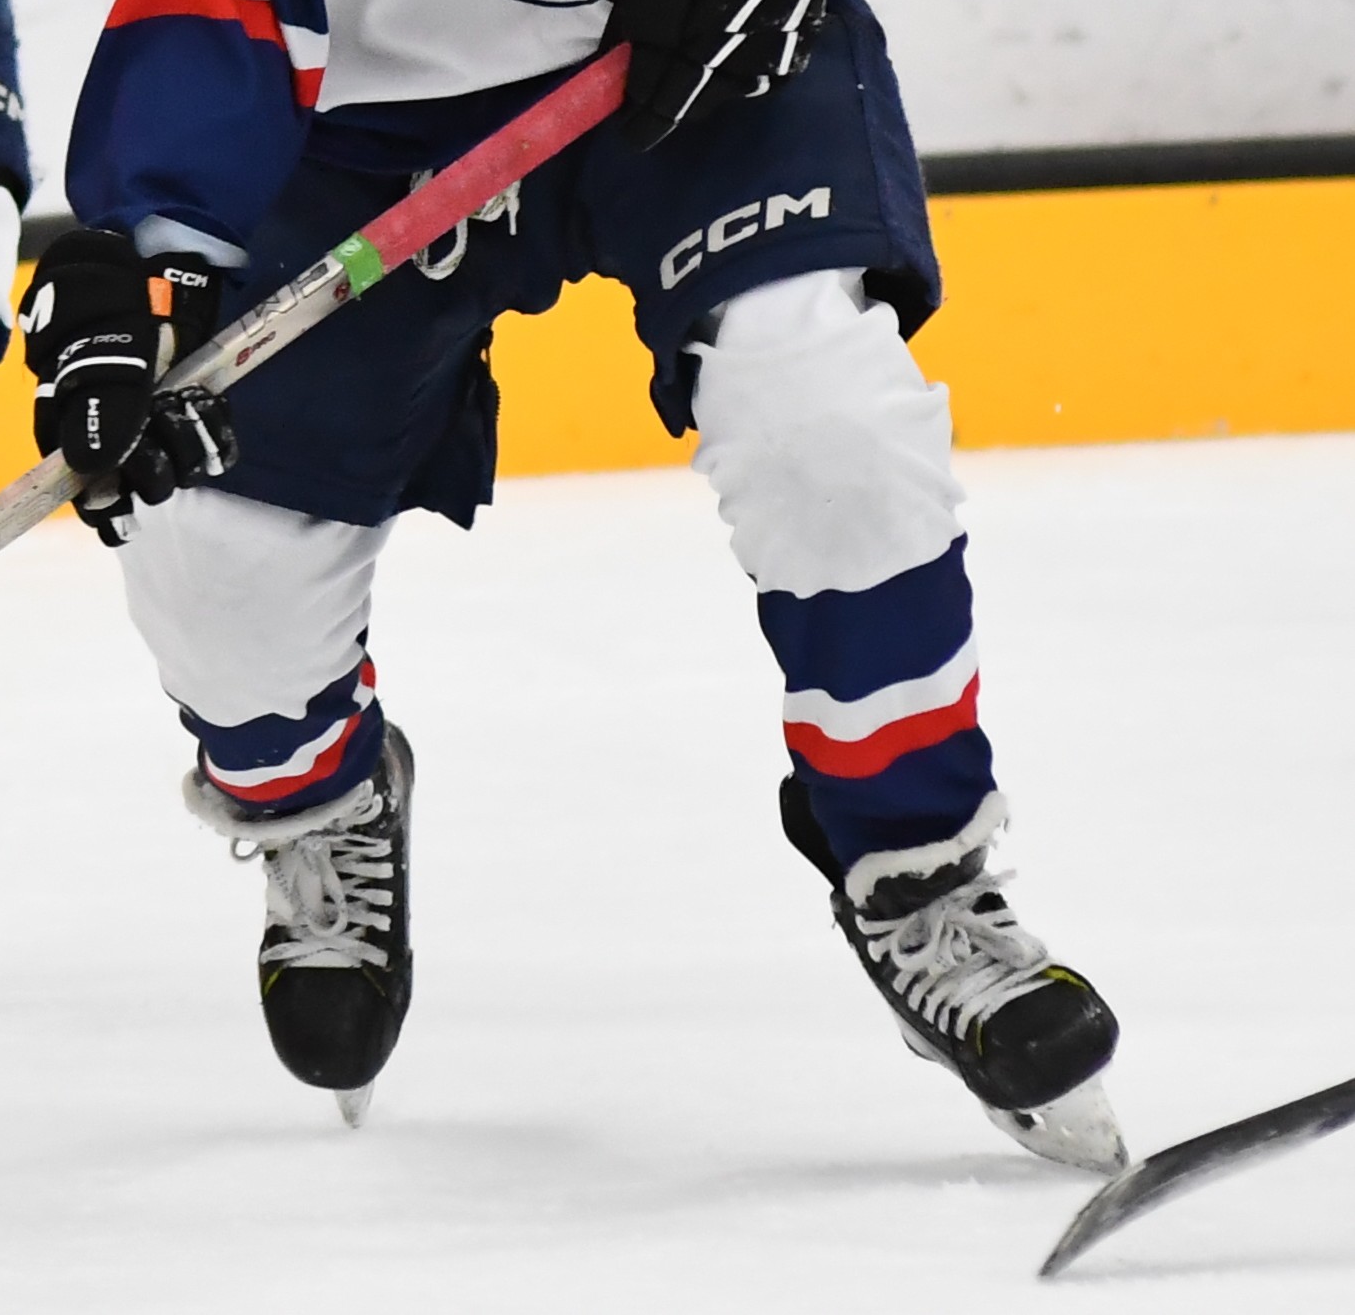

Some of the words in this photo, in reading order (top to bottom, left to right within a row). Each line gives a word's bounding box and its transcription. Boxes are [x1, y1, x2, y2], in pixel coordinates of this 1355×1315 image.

[659, 187, 831, 290] CCM
[163, 268, 208, 288] CCM
[92, 333, 134, 345] PRO
